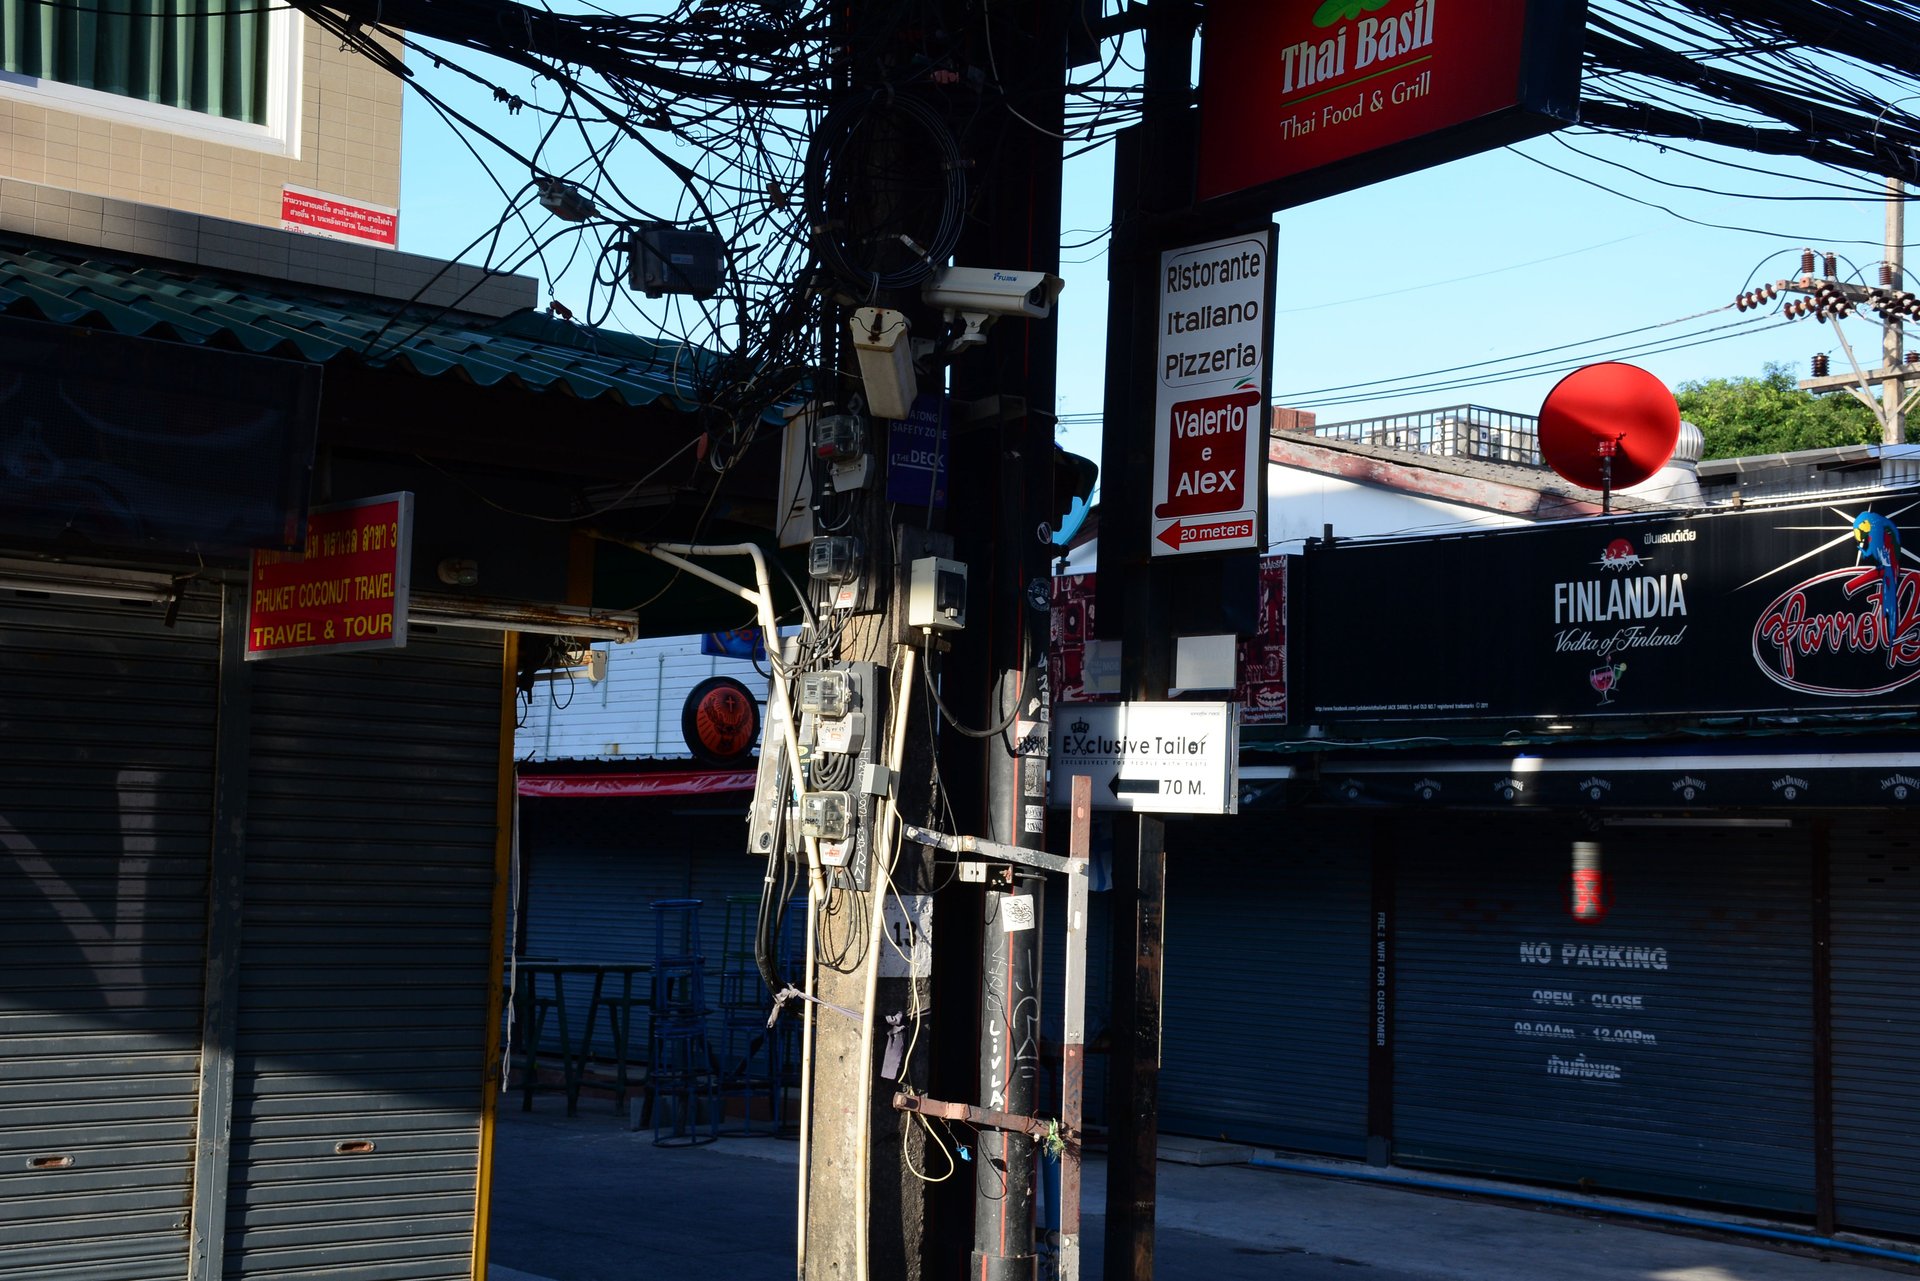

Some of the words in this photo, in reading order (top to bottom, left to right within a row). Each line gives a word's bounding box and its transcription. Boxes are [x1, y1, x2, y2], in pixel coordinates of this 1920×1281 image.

[1281, 25, 1347, 94] Thai
[1354, 0, 1435, 70] Basil
[1280, 111, 1316, 141] Thai
[1323, 92, 1364, 128] Food
[1369, 90, 1383, 113] &
[1391, 70, 1431, 105] Grill
[1166, 252, 1260, 293] Ristorante
[1167, 300, 1259, 335] Italiano
[1165, 343, 1256, 379] Pizzeria
[891, 422, 924, 436] SAFETY
[924, 428, 948, 440] ZOE
[1174, 404, 1244, 439] Valerio
[911, 449, 945, 467] DECK
[1201, 447, 1212, 461] e
[1175, 468, 1236, 497] Alex
[362, 522, 387, 551] สาขา
[391, 522, 398, 549] 3
[1180, 529, 1197, 541] 20
[1199, 524, 1249, 539] meters
[255, 585, 296, 613] PHUKET
[298, 578, 351, 608] COCONUT
[355, 573, 395, 601] TRAVEL
[1554, 573, 1687, 624] FINLANDIA
[253, 622, 316, 647] TRAVEL
[323, 619, 335, 640] &
[343, 612, 393, 637] TOUR
[1554, 628, 1599, 653] Vodka
[1597, 628, 1625, 656] of
[1616, 624, 1688, 651] Finland
[1155, 735, 1207, 755] Tailor
[1164, 780, 1182, 795] 70
[1188, 780, 1206, 796] M.
[893, 921, 917, 948] 13
[1377, 941, 1386, 962] WIFI
[1519, 941, 1552, 964] NO
[1561, 943, 1669, 970] PARKING
[1377, 966, 1386, 987] FOR
[1532, 990, 1575, 1007] OPEN
[1591, 994, 1645, 1010] CLOSE
[1377, 989, 1386, 1047] CUSTOMER
